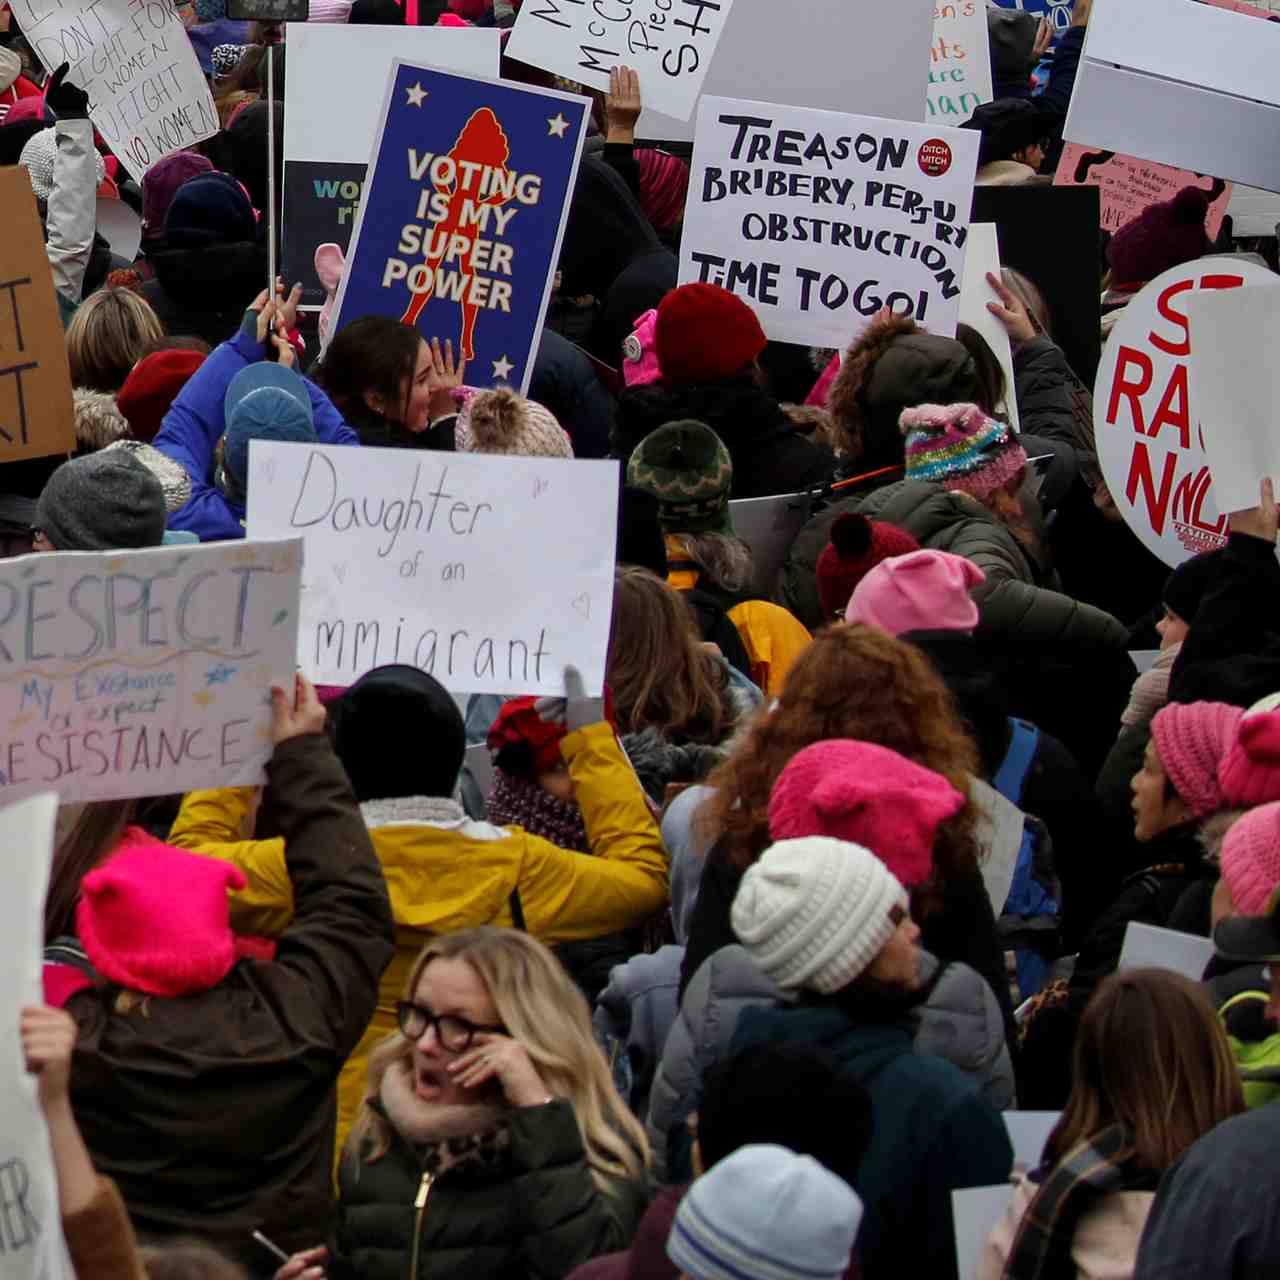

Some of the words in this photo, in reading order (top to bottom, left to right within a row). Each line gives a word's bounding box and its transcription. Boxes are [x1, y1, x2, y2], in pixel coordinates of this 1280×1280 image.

[104, 36, 168, 94] WOMEN
[126, 137, 150, 169] NO
[718, 115, 909, 171] TREASON
[921, 155, 947, 165] MITCH
[922, 145, 948, 154] DITCH
[407, 148, 542, 205] VOTING
[702, 167, 856, 210] BRIBERY,
[416, 189, 449, 223] IS
[458, 199, 518, 236] MY
[398, 224, 514, 276] SUPER
[741, 212, 961, 300] OBSTRUCTION
[382, 257, 513, 312] POWER
[288, 449, 492, 559] Daughter
[399, 551, 424, 581] of
[441, 561, 466, 584] an
